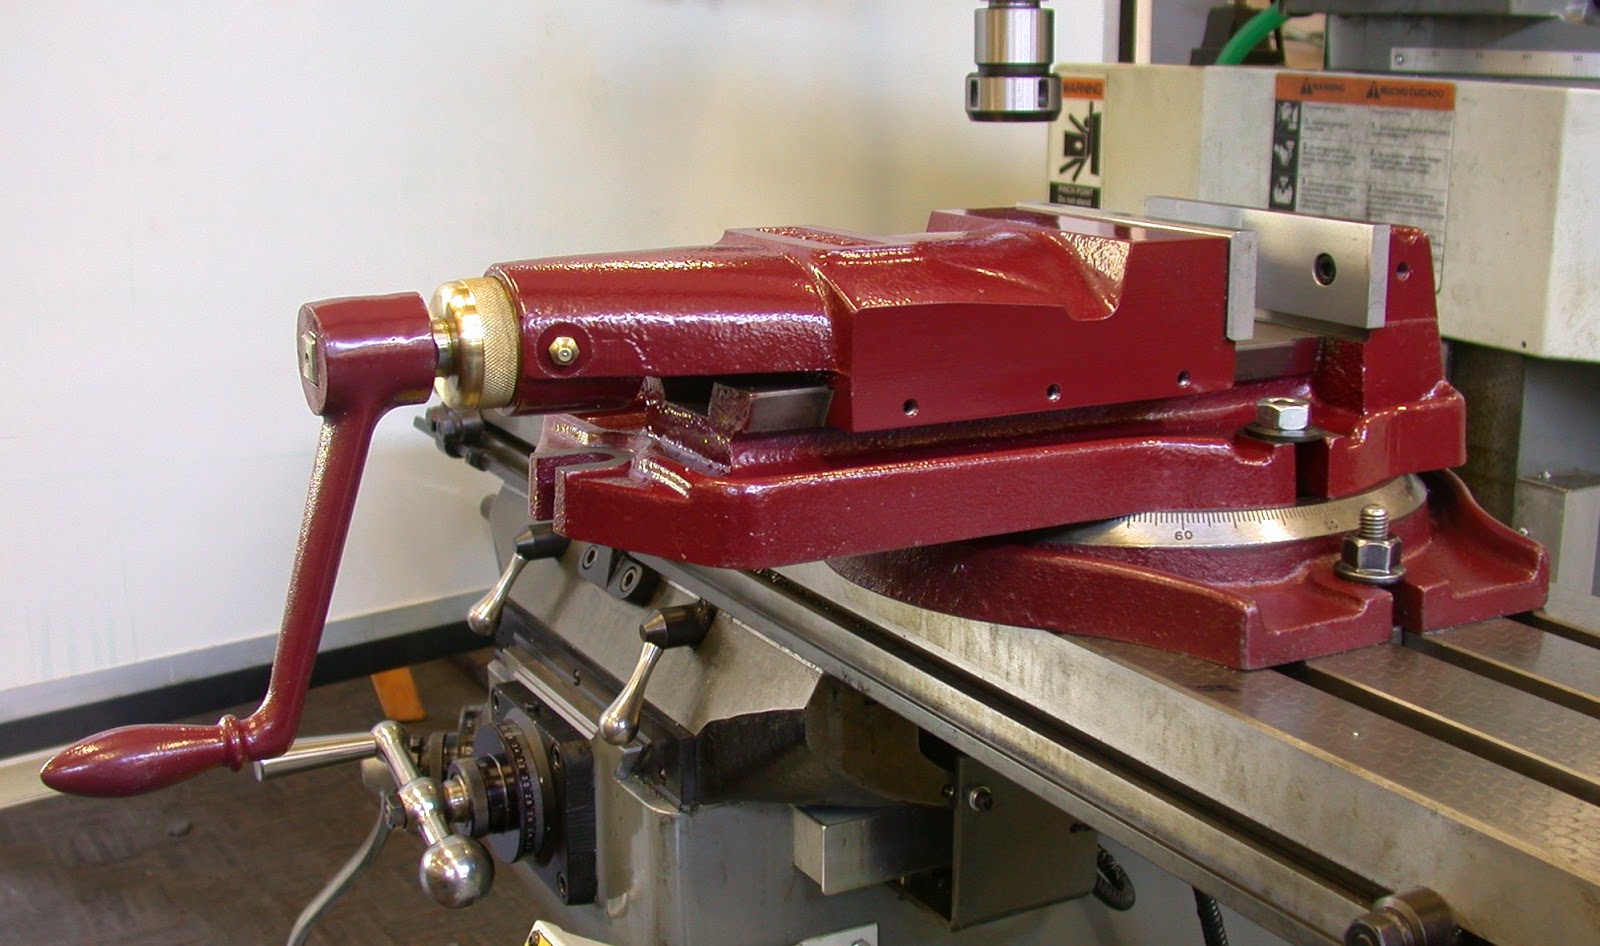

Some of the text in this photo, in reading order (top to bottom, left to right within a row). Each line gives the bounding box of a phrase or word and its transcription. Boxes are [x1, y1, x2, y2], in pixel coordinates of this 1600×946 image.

[1063, 82, 1103, 95] WARNING
[1380, 86, 1445, 98] MUCHO CUIDADO
[1174, 530, 1193, 541] 60
